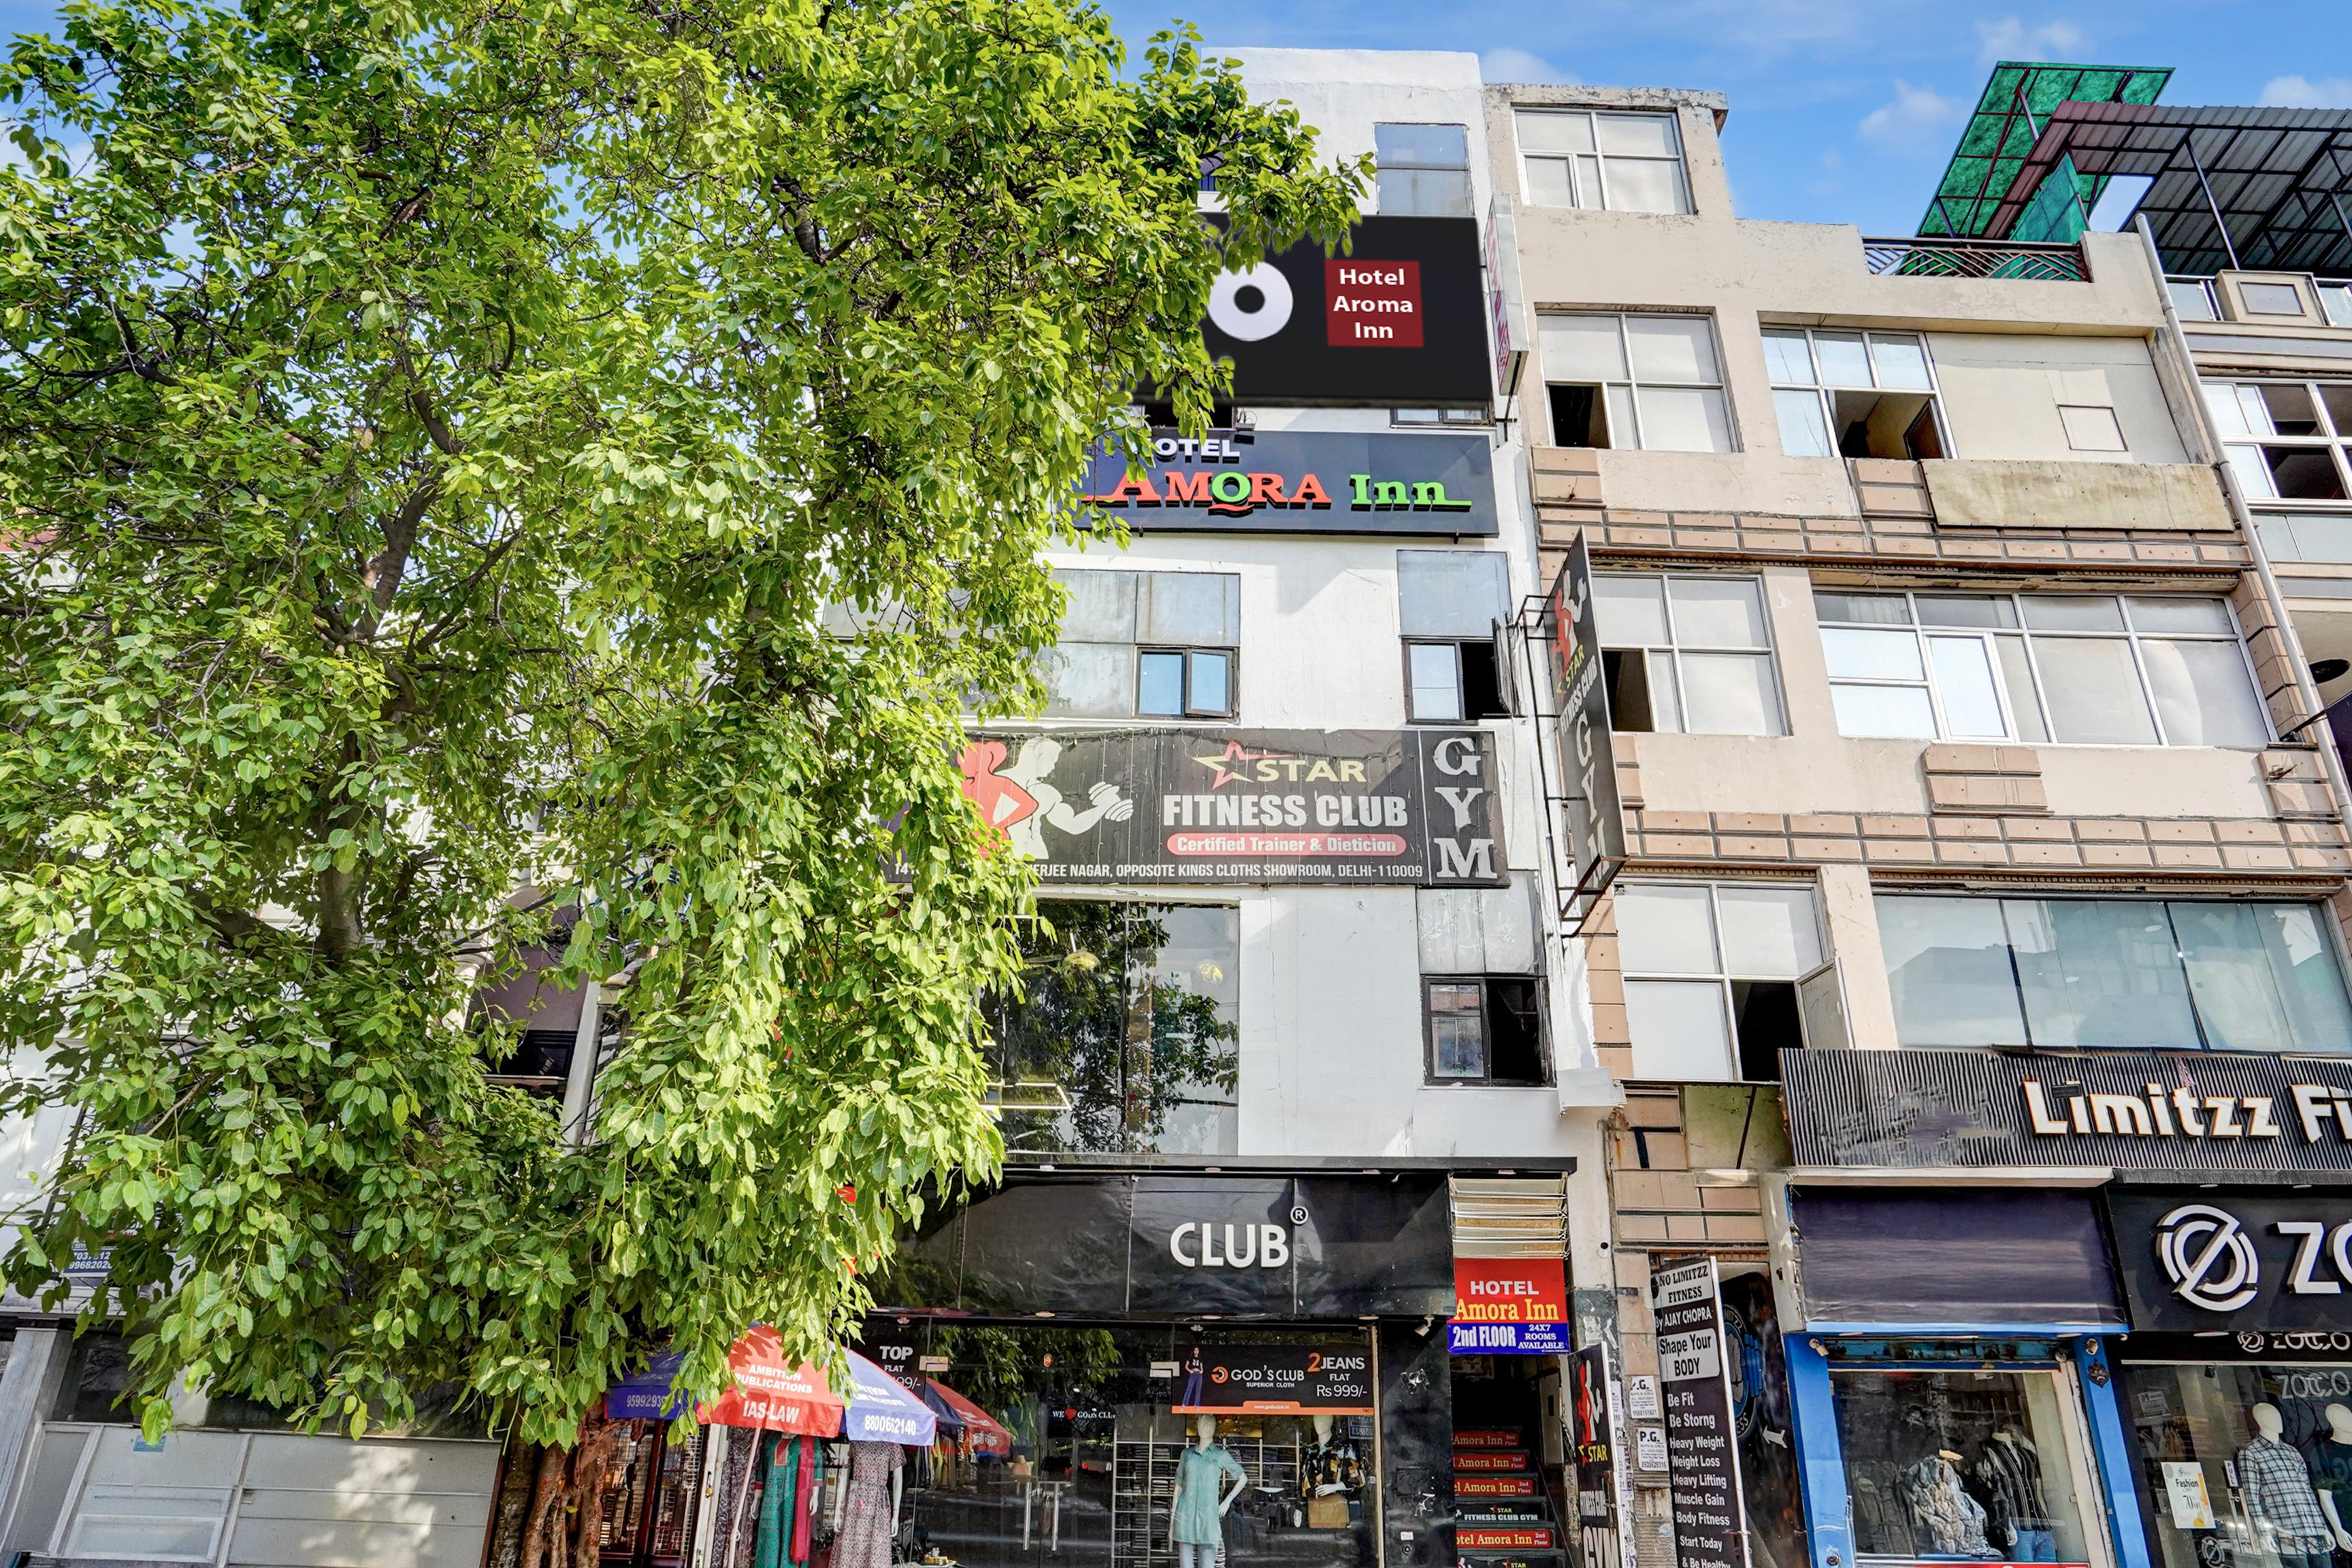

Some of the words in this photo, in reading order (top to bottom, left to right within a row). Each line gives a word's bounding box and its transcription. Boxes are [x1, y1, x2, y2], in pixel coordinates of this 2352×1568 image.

[1339, 269, 1405, 286] Hotel
[1333, 295, 1414, 313] Aroma
[1354, 323, 1394, 339] Inn
[1138, 438, 1240, 457] OTEL
[1081, 471, 1331, 505] AMORA
[1350, 474, 1471, 506] Inn
[1565, 644, 1585, 690] STAR
[1560, 683, 1582, 738] FITNESS
[1581, 655, 1598, 698] CLUB
[1256, 760, 1367, 783] STAR
[1164, 795, 1315, 826] FITNESS
[1316, 795, 1408, 827] CLUB
[1433, 736, 1497, 879] GYM
[1177, 836, 1247, 852] Certified
[1250, 837, 1305, 851] Trainer
[1309, 838, 1322, 851] &
[1328, 837, 1396, 852] Dieticion
[1070, 864, 1113, 878] NAGAR,
[1116, 864, 1176, 877] OPPOSOTE
[1178, 864, 1213, 877] KINGS
[1216, 864, 1260, 877] CLOTHS
[1263, 864, 1335, 878] SHOWROOM,
[1338, 864, 1423, 877] DELHI-110009
[2023, 1078, 2280, 1138] Limitzz
[1169, 1222, 1290, 1269] CLUB
[1659, 1274, 1671, 1287] NO
[1673, 1265, 1708, 1284] LIMITZZ
[1470, 1280, 1539, 1295] HOTEL
[1668, 1286, 1702, 1303] FITNESS
[1454, 1298, 1520, 1320] Amora
[1524, 1298, 1559, 1320] Inn
[1664, 1310, 1682, 1328] AJAY
[1682, 1305, 1712, 1325] CHOPRA
[1453, 1326, 1477, 1347] 2nd
[1479, 1326, 1516, 1347] FLOOR
[1659, 1338, 1688, 1356] Shape
[1689, 1333, 1712, 1351] Your
[879, 1345, 913, 1360] TOP
[885, 1365, 904, 1373] FLAT
[1307, 1352, 1321, 1372] 2
[1320, 1357, 1365, 1370] JEANS
[1674, 1357, 1700, 1377] BODY
[735, 1373, 813, 1394] PUBLICATIONS
[894, 1376, 921, 1390] 99/-
[1275, 1369, 1305, 1382] CLUB
[1333, 1385, 1367, 1397] 999/-
[1667, 1393, 1680, 1407] Be
[1682, 1392, 1695, 1406] Fit
[1669, 1414, 1682, 1428] Be
[1684, 1413, 1716, 1429] Storng
[1452, 1435, 1484, 1445] Amora
[1488, 1435, 1503, 1445] Inn
[1640, 1431, 1660, 1442] P.G.
[1669, 1437, 1694, 1451] Heavy
[1695, 1435, 1725, 1450] Weight
[1588, 1444, 1607, 1463] STAR
[1458, 1458, 1490, 1467] Amora
[1493, 1458, 1509, 1467] Inn
[1671, 1455, 1699, 1470] Weight
[1701, 1455, 1720, 1467] Loss
[1463, 1482, 1497, 1492] Amora
[1499, 1482, 1516, 1492] Inn
[1673, 1474, 1697, 1488] Heavy
[1699, 1473, 1727, 1489] Lifting
[2175, 1478, 2199, 1488] Fashion
[1580, 1490, 1595, 1516] FITNESS
[1674, 1492, 1703, 1505] Muscle
[1705, 1492, 1725, 1505] Gain
[1676, 1511, 1697, 1526] Body
[1698, 1512, 1730, 1526] Fitness
[1456, 1534, 1474, 1544] otel
[1477, 1534, 1512, 1544] Amora
[1514, 1534, 1532, 1544] Inn
[1680, 1535, 1699, 1548] Start
[1699, 1536, 1722, 1552] Today
[1682, 1556, 1688, 1568] &
[1689, 1557, 1699, 1568] Be
